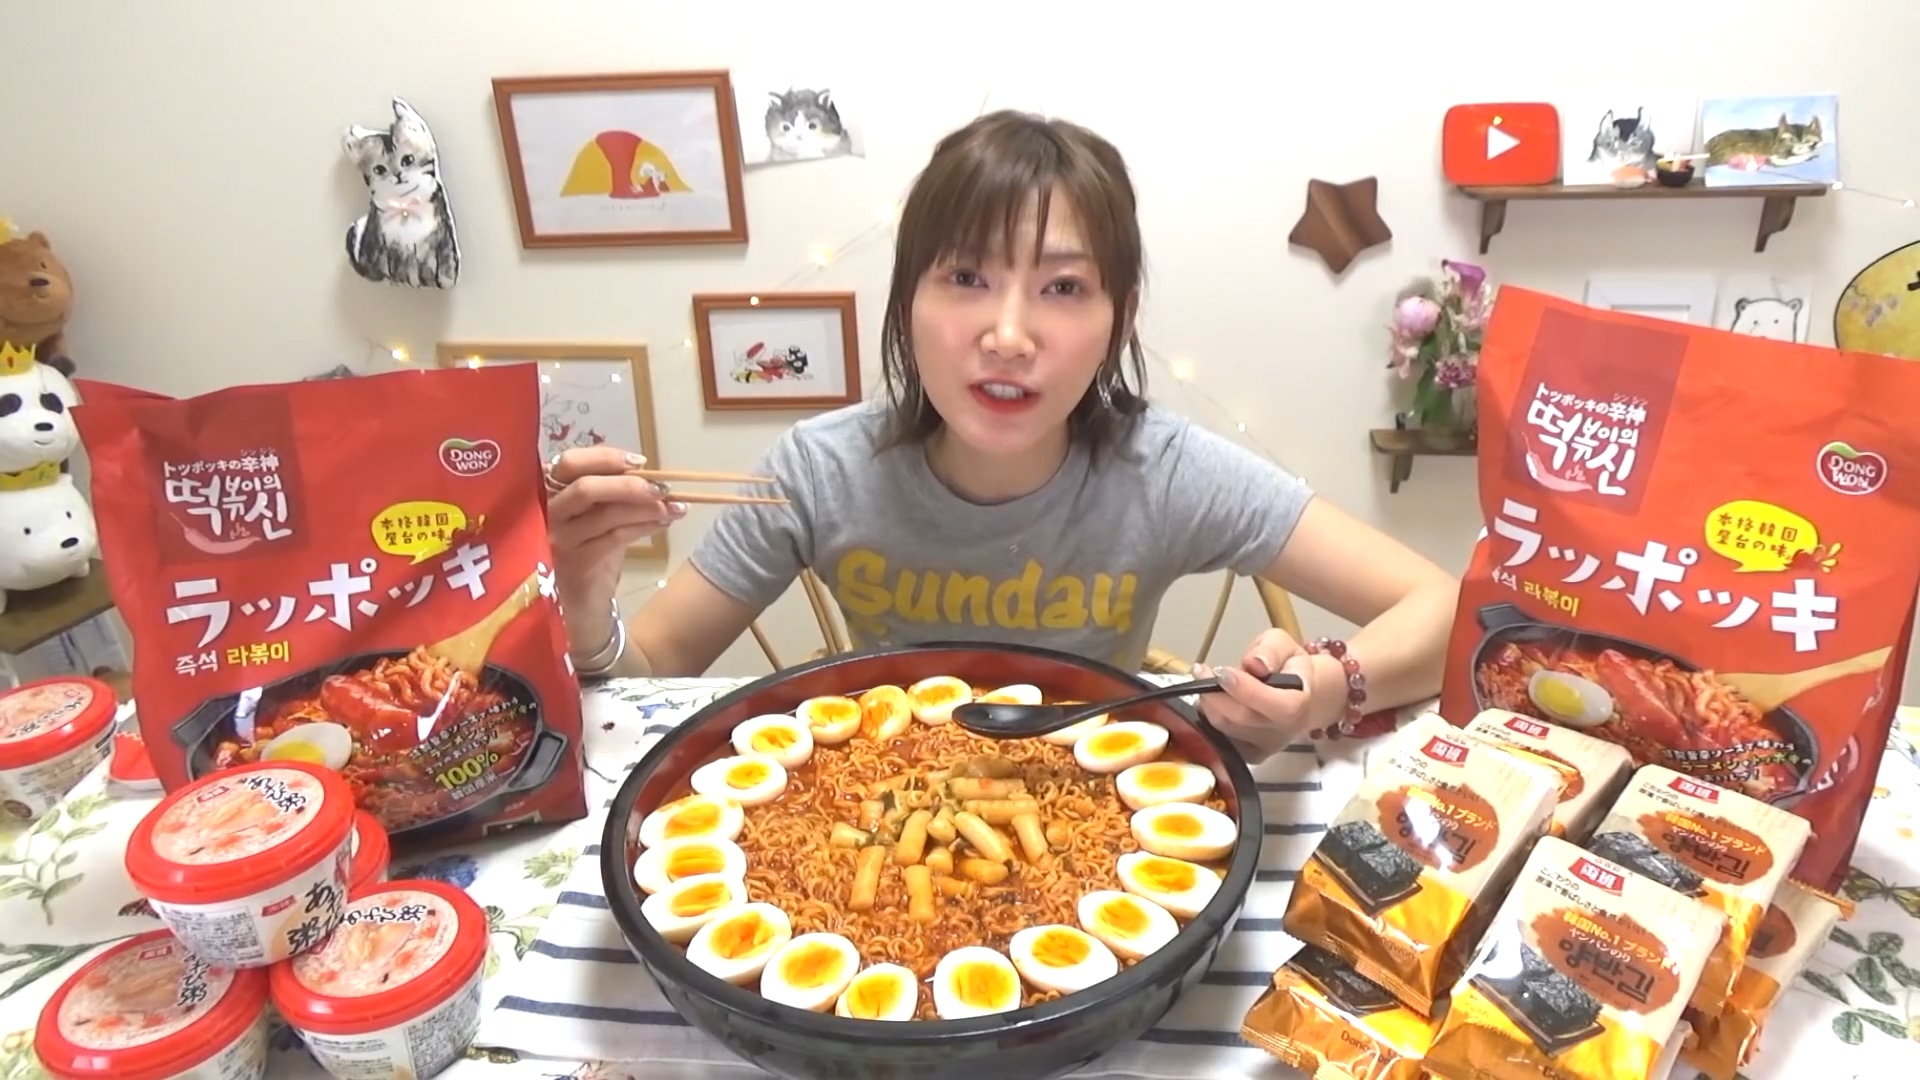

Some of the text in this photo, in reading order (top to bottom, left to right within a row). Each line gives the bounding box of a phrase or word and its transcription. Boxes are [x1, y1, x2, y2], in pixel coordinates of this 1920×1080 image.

[1535, 382, 1647, 426] トッポッキの辛神
[449, 449, 493, 462] DONG
[456, 460, 488, 471] WON
[1829, 455, 1876, 478] DONG
[1832, 469, 1871, 488] WON
[381, 513, 449, 531] 本格韓国
[1717, 512, 1798, 543] 本格韓国
[837, 547, 1138, 634] Sunday
[1494, 497, 1839, 652] ラッポッキ
[166, 543, 492, 648] ラッポッキ
[1523, 581, 1579, 618] 라볶이
[175, 640, 290, 677] 즉석 라볶이
[435, 749, 499, 790] 100%
[1558, 938, 1655, 1005] 양반김
